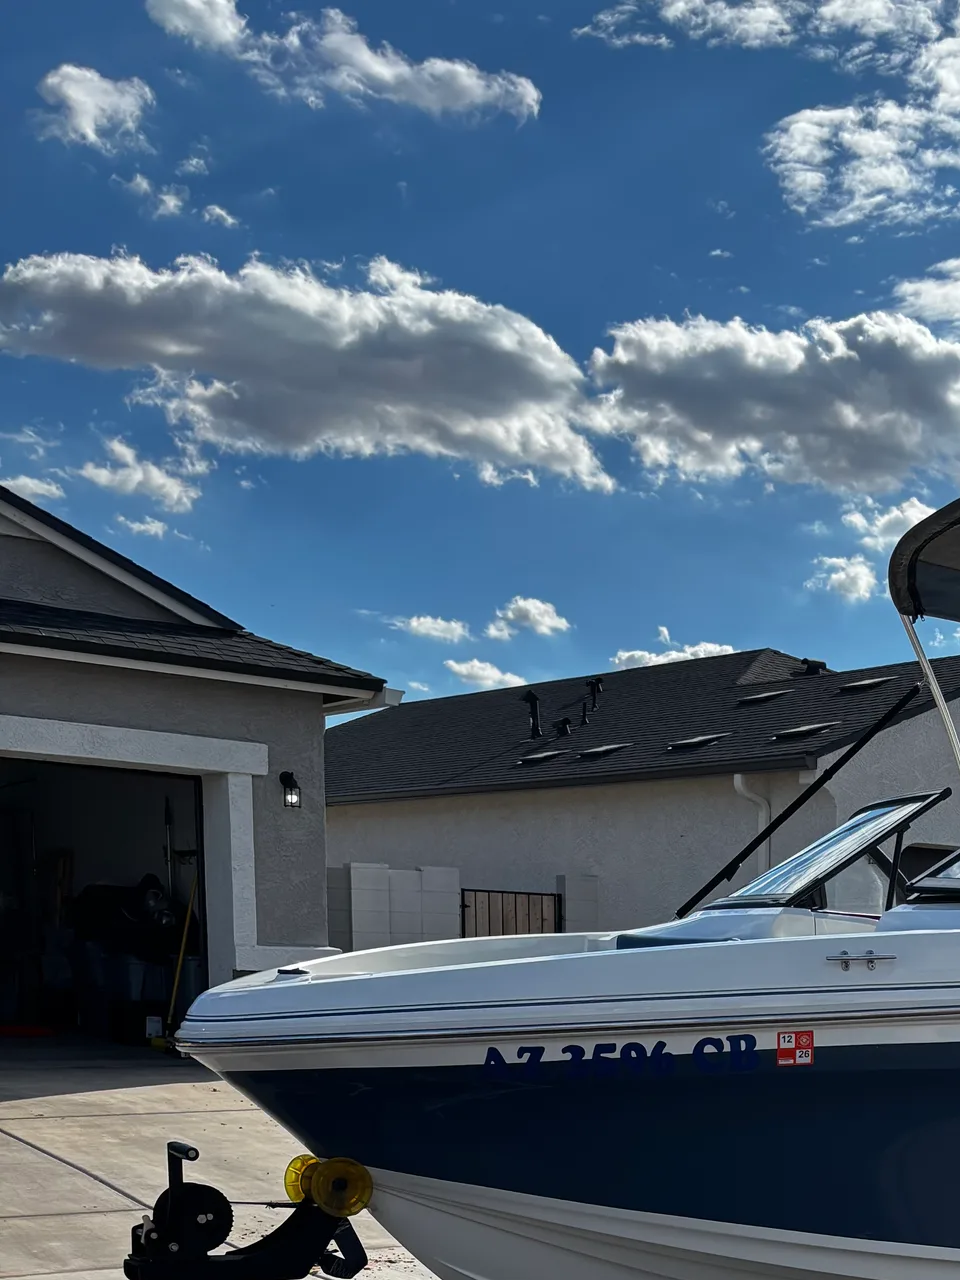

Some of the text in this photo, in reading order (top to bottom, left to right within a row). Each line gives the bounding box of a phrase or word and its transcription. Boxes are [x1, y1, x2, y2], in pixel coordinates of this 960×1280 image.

[781, 1035, 793, 1044] 12
[798, 1050, 810, 1058] 26
[482, 1046, 545, 1080] AZ
